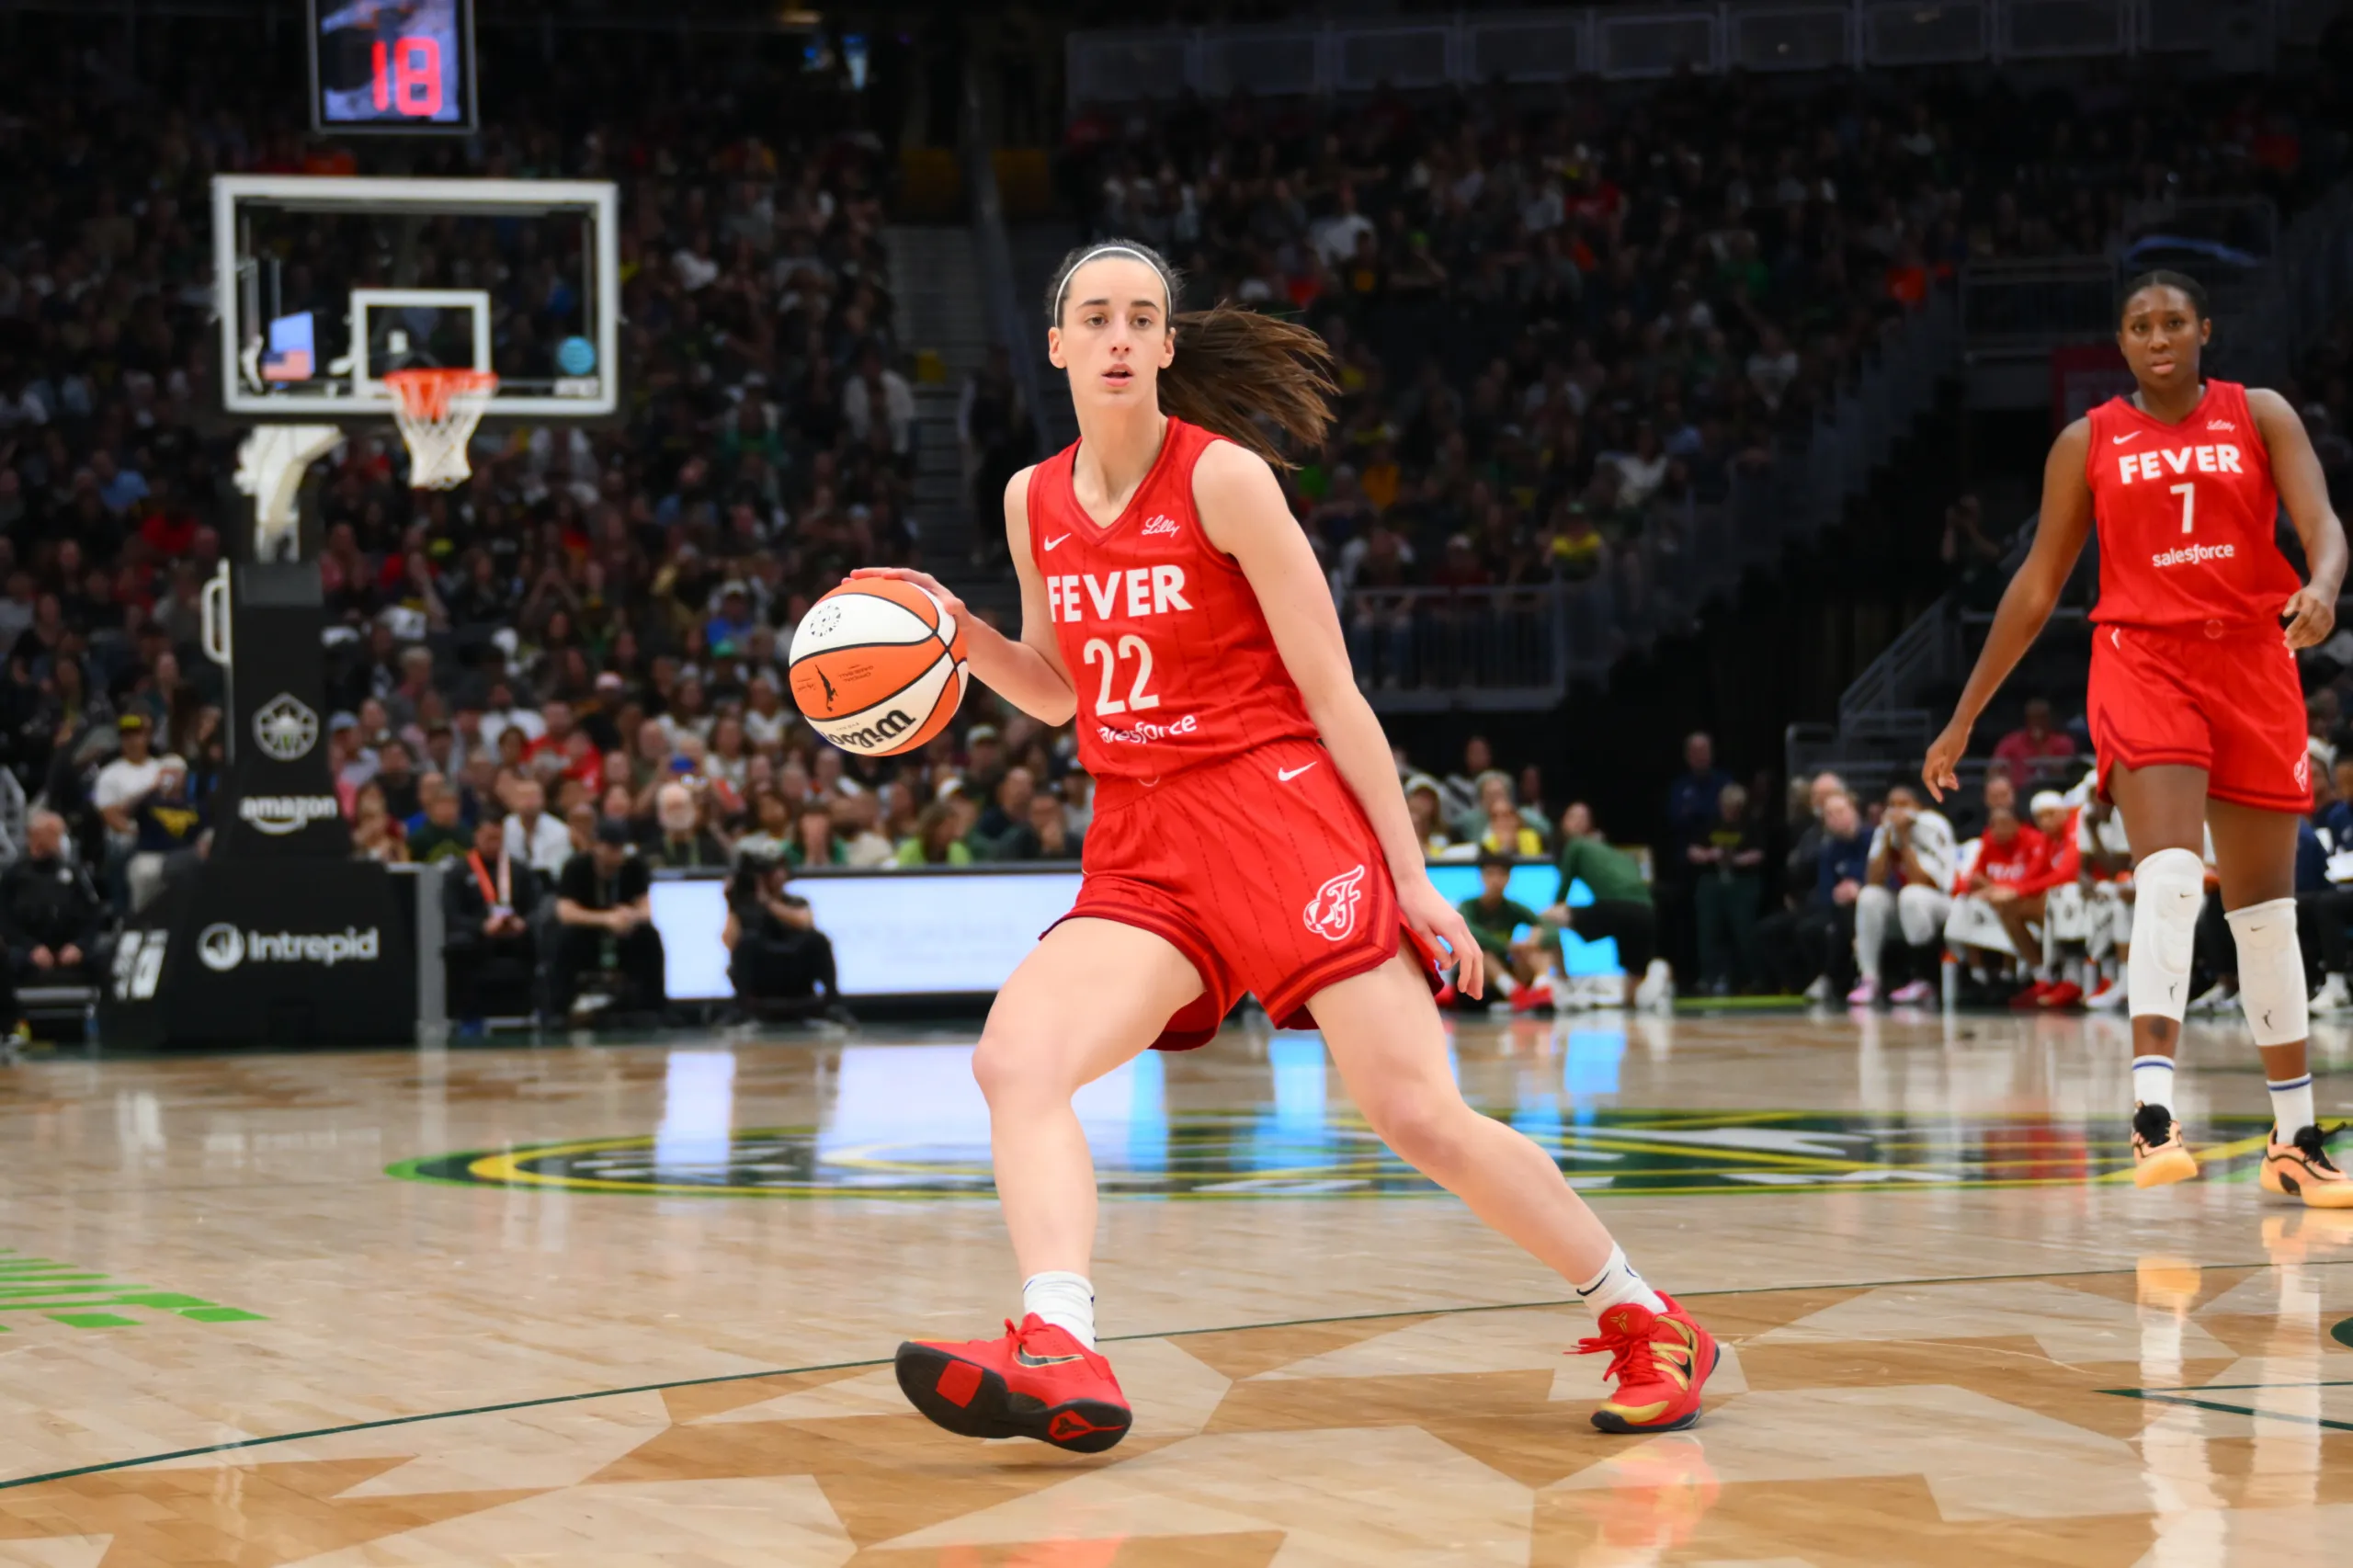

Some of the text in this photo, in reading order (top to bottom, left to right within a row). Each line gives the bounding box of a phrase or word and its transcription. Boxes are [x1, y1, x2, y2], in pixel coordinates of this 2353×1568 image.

[371, 37, 442, 117] 18
[2118, 444, 2243, 484] FEVER
[1142, 515, 1179, 538] Lilly
[2169, 483, 2194, 533] 7
[2152, 544, 2234, 567] salesforce
[1047, 564, 1193, 623] FEVER
[1083, 634, 1160, 717] 22
[239, 795, 337, 822] amazon
[247, 926, 379, 968] Intrepid
